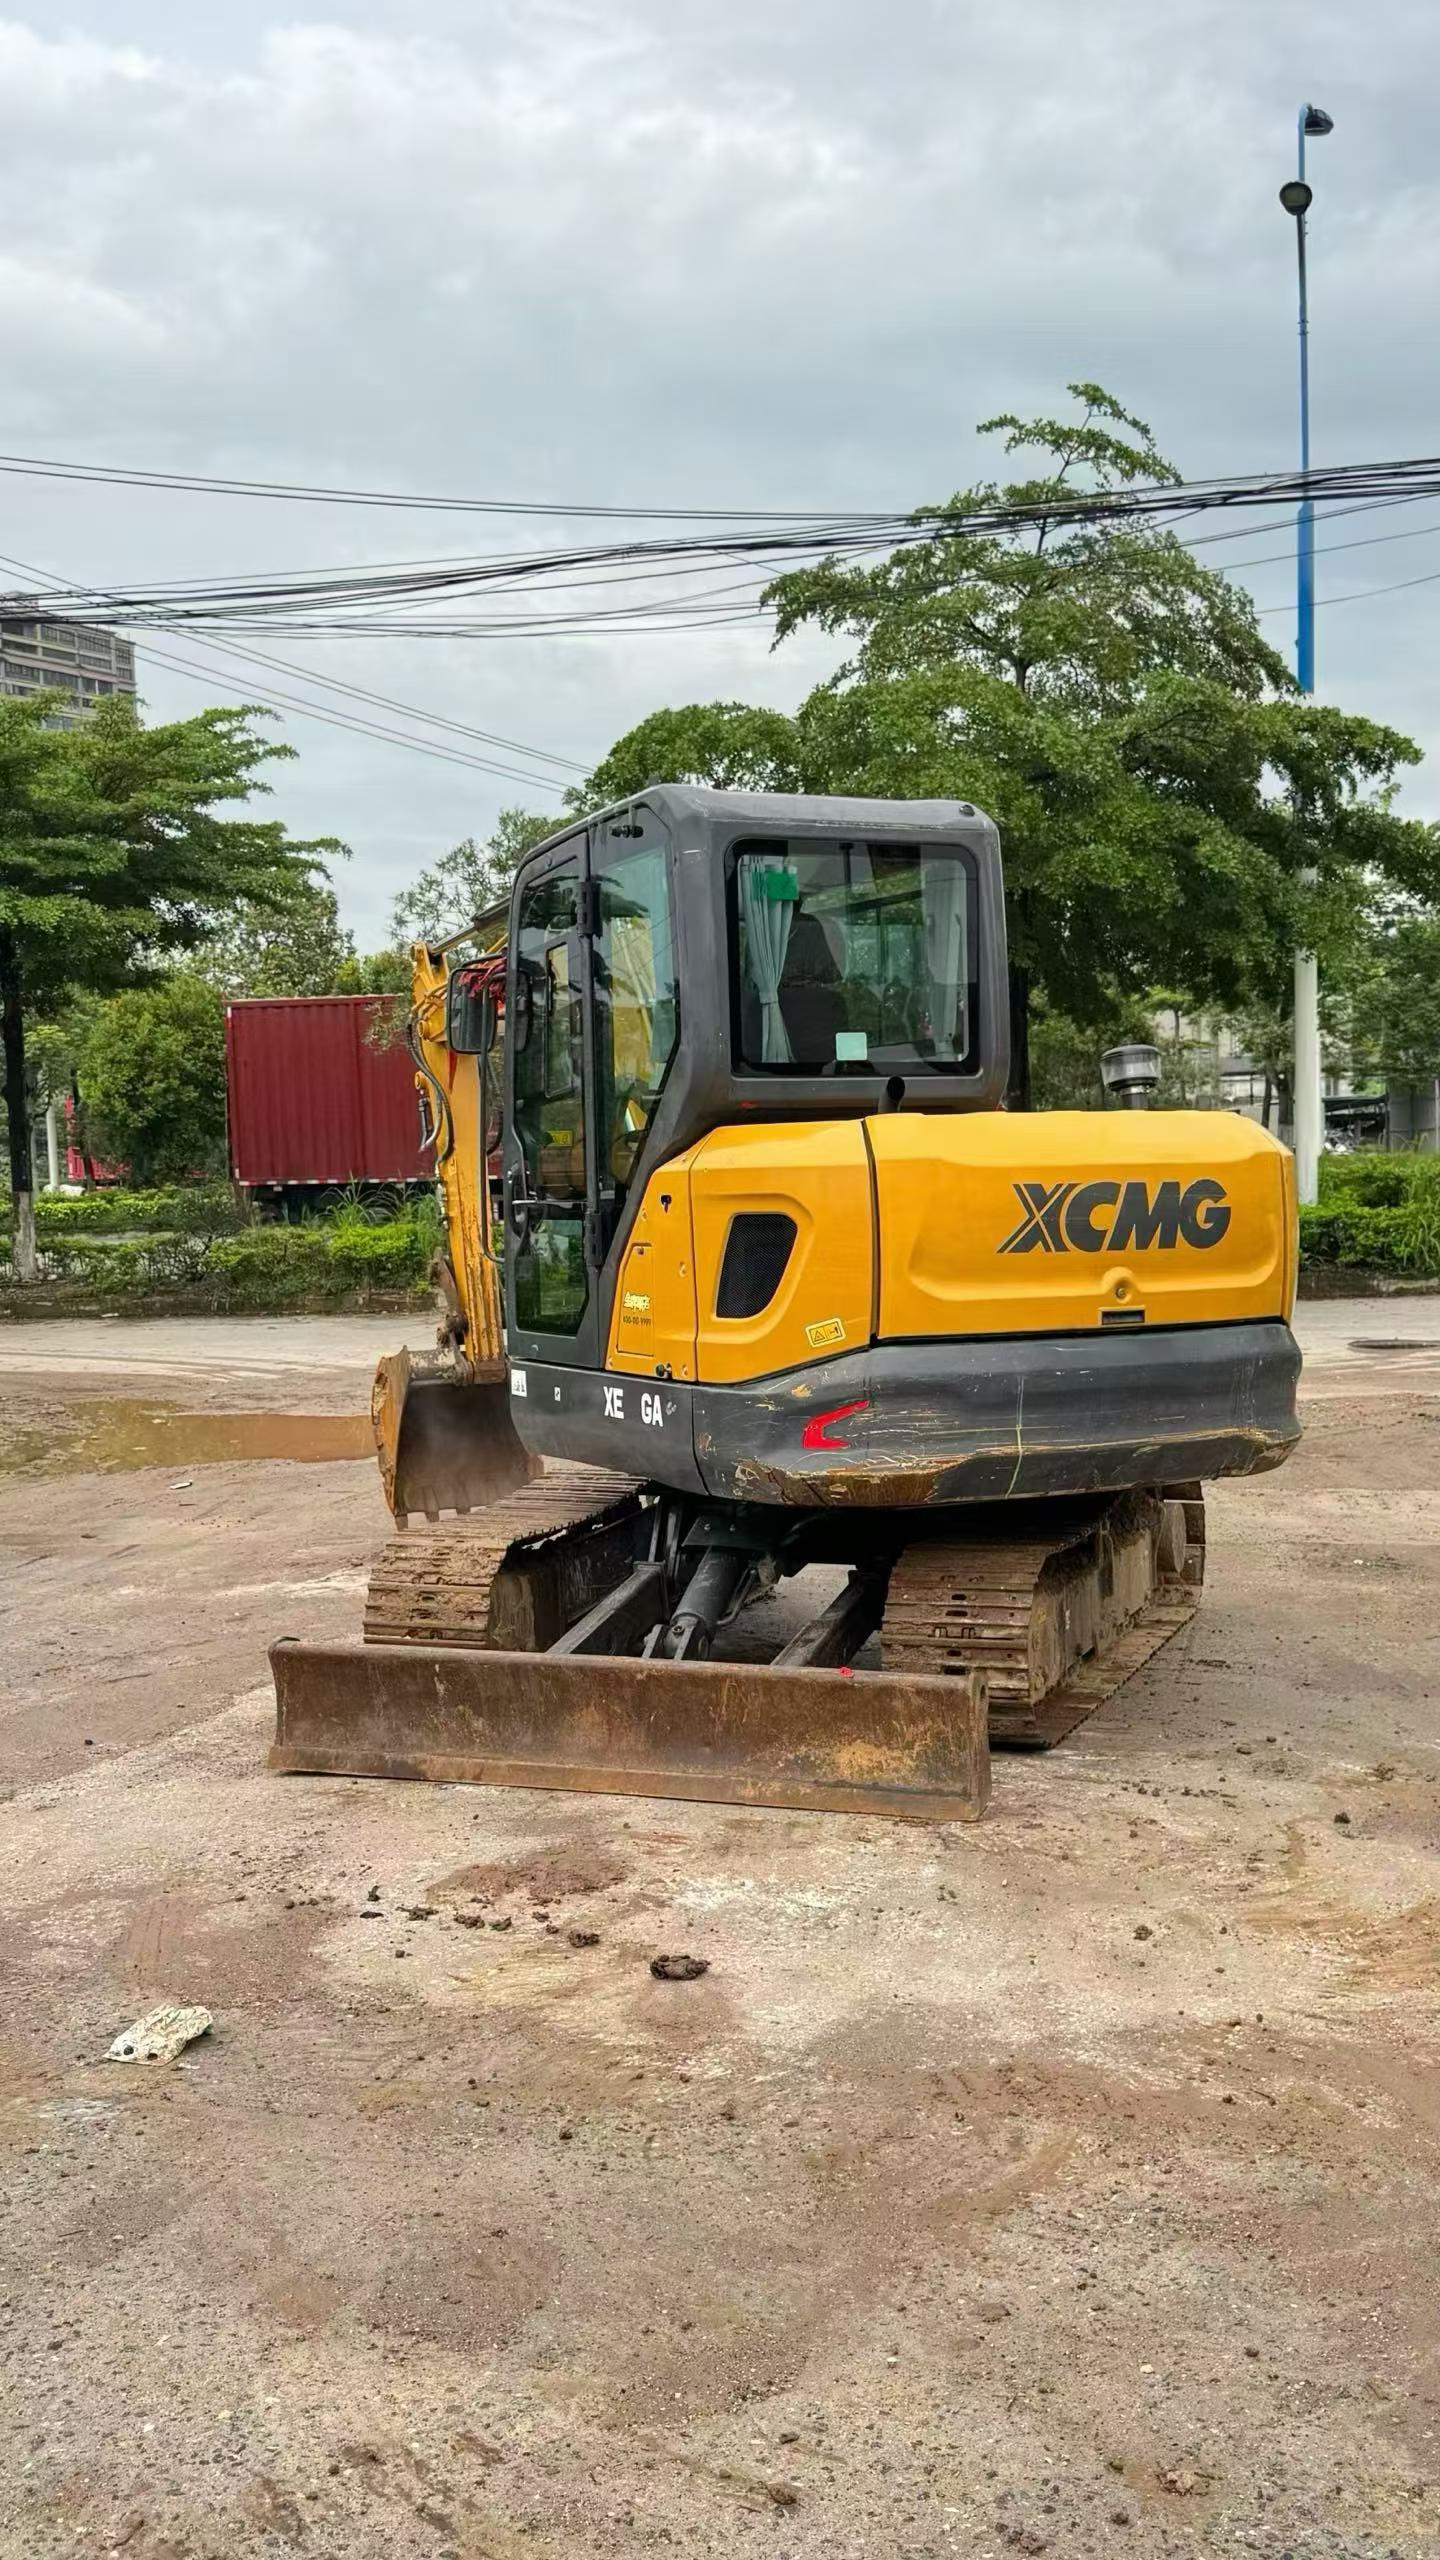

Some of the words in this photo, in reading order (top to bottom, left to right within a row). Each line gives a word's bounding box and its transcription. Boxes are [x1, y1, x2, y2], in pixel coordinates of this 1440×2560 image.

[996, 1179, 1231, 1253] XCMG
[603, 1386, 625, 1419] XE
[640, 1392, 664, 1427] GA
